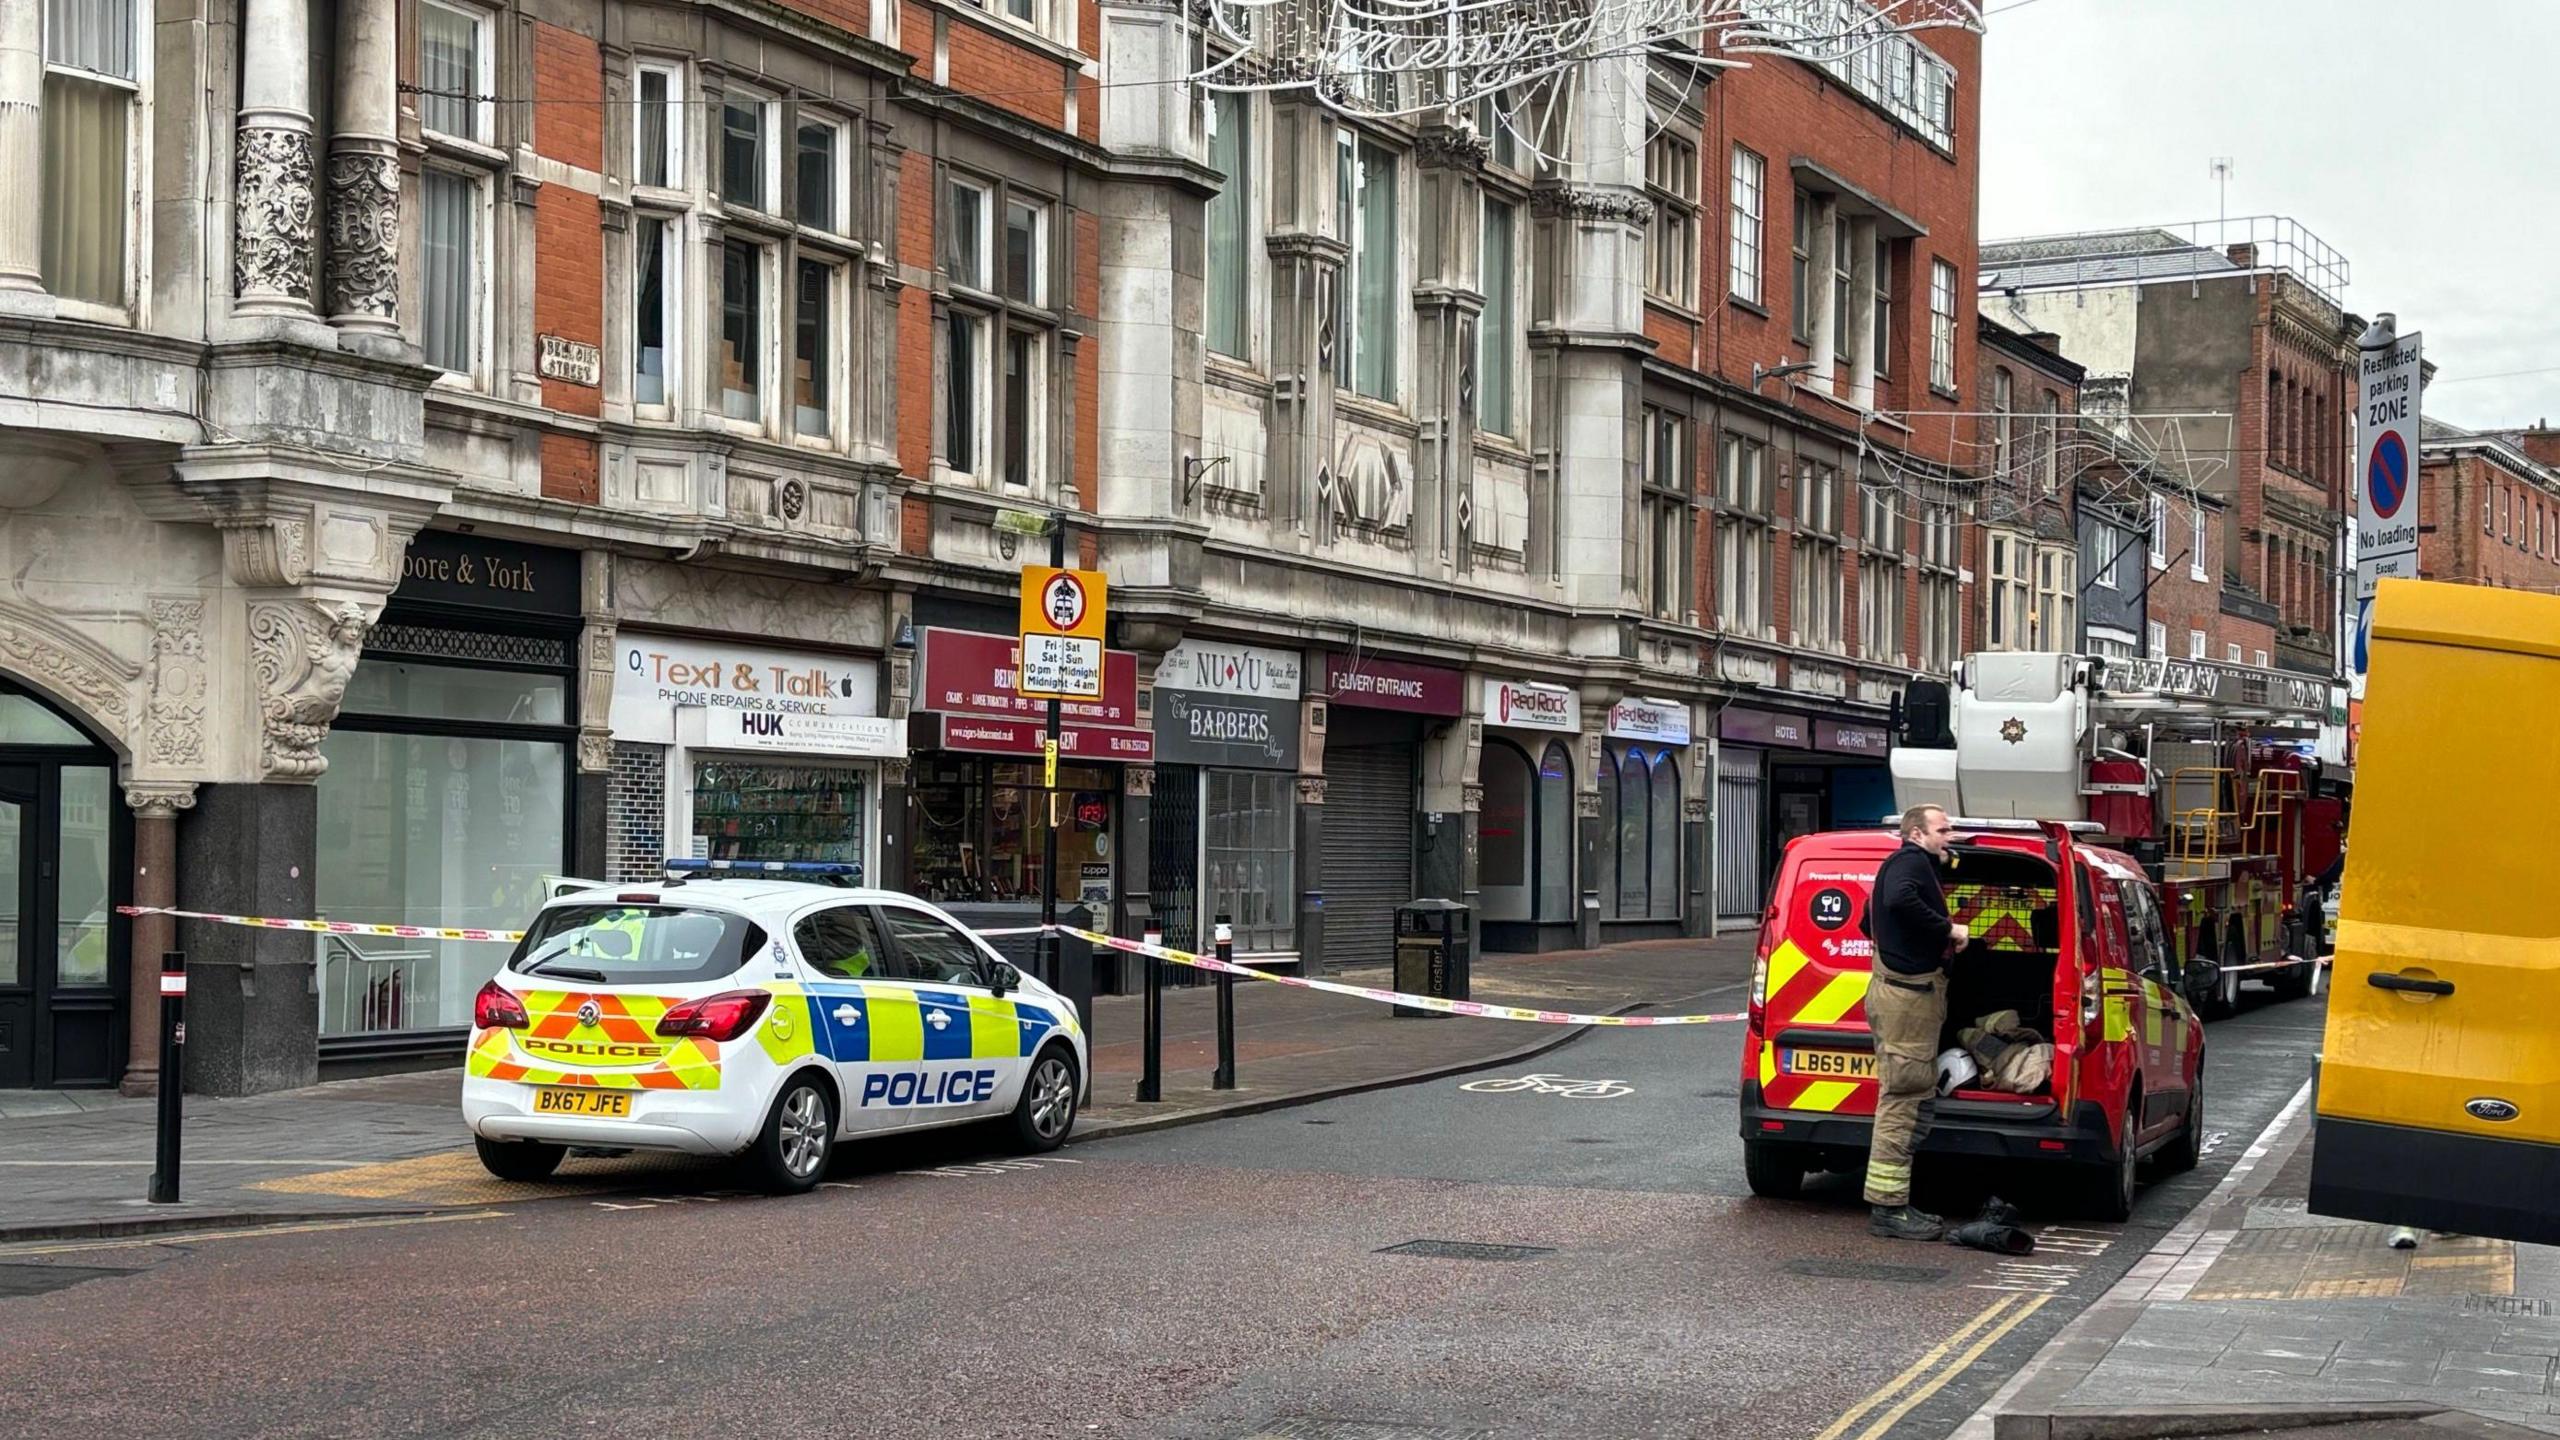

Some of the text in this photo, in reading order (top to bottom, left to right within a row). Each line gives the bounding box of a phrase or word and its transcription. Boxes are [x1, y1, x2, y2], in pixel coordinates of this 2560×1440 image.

[2363, 345, 2417, 376] Restricted
[2369, 373, 2409, 400] parking
[2369, 396, 2408, 427] ZONE
[2361, 526, 2416, 550] No loading
[403, 554, 535, 592] oore & York
[2375, 561, 2398, 575] Except
[2364, 580, 2370, 591] in
[1045, 640, 1081, 653] Fri Sat
[1042, 652, 1083, 665] Sat Sun
[649, 653, 839, 699] Text & Talk
[1025, 663, 1098, 679] 10 pm Midnight
[1027, 676, 1095, 690] Midnight 4 am
[1376, 677, 1423, 698] ENTRANCE
[658, 688, 827, 716] PHONE REPAIRS & SERVICE
[1169, 692, 1189, 720] The
[1511, 689, 1568, 714] Red Rock
[741, 712, 784, 737] HUK
[788, 719, 887, 733] COMMUNICATIONS
[1190, 708, 1269, 742] BARBERS
[1618, 704, 1659, 724] Red Rock
[1775, 725, 1798, 741] HOTEL
[1836, 729, 1849, 746] CAR
[1850, 731, 1867, 748] PARK
[1263, 734, 1284, 764] Shop
[525, 1039, 662, 1057] POLICE
[1795, 1052, 1845, 1073] LB69
[861, 1069, 996, 1107] POLICE
[540, 1091, 625, 1113] BX67 JFE
[2477, 1102, 2508, 1116] Ford
